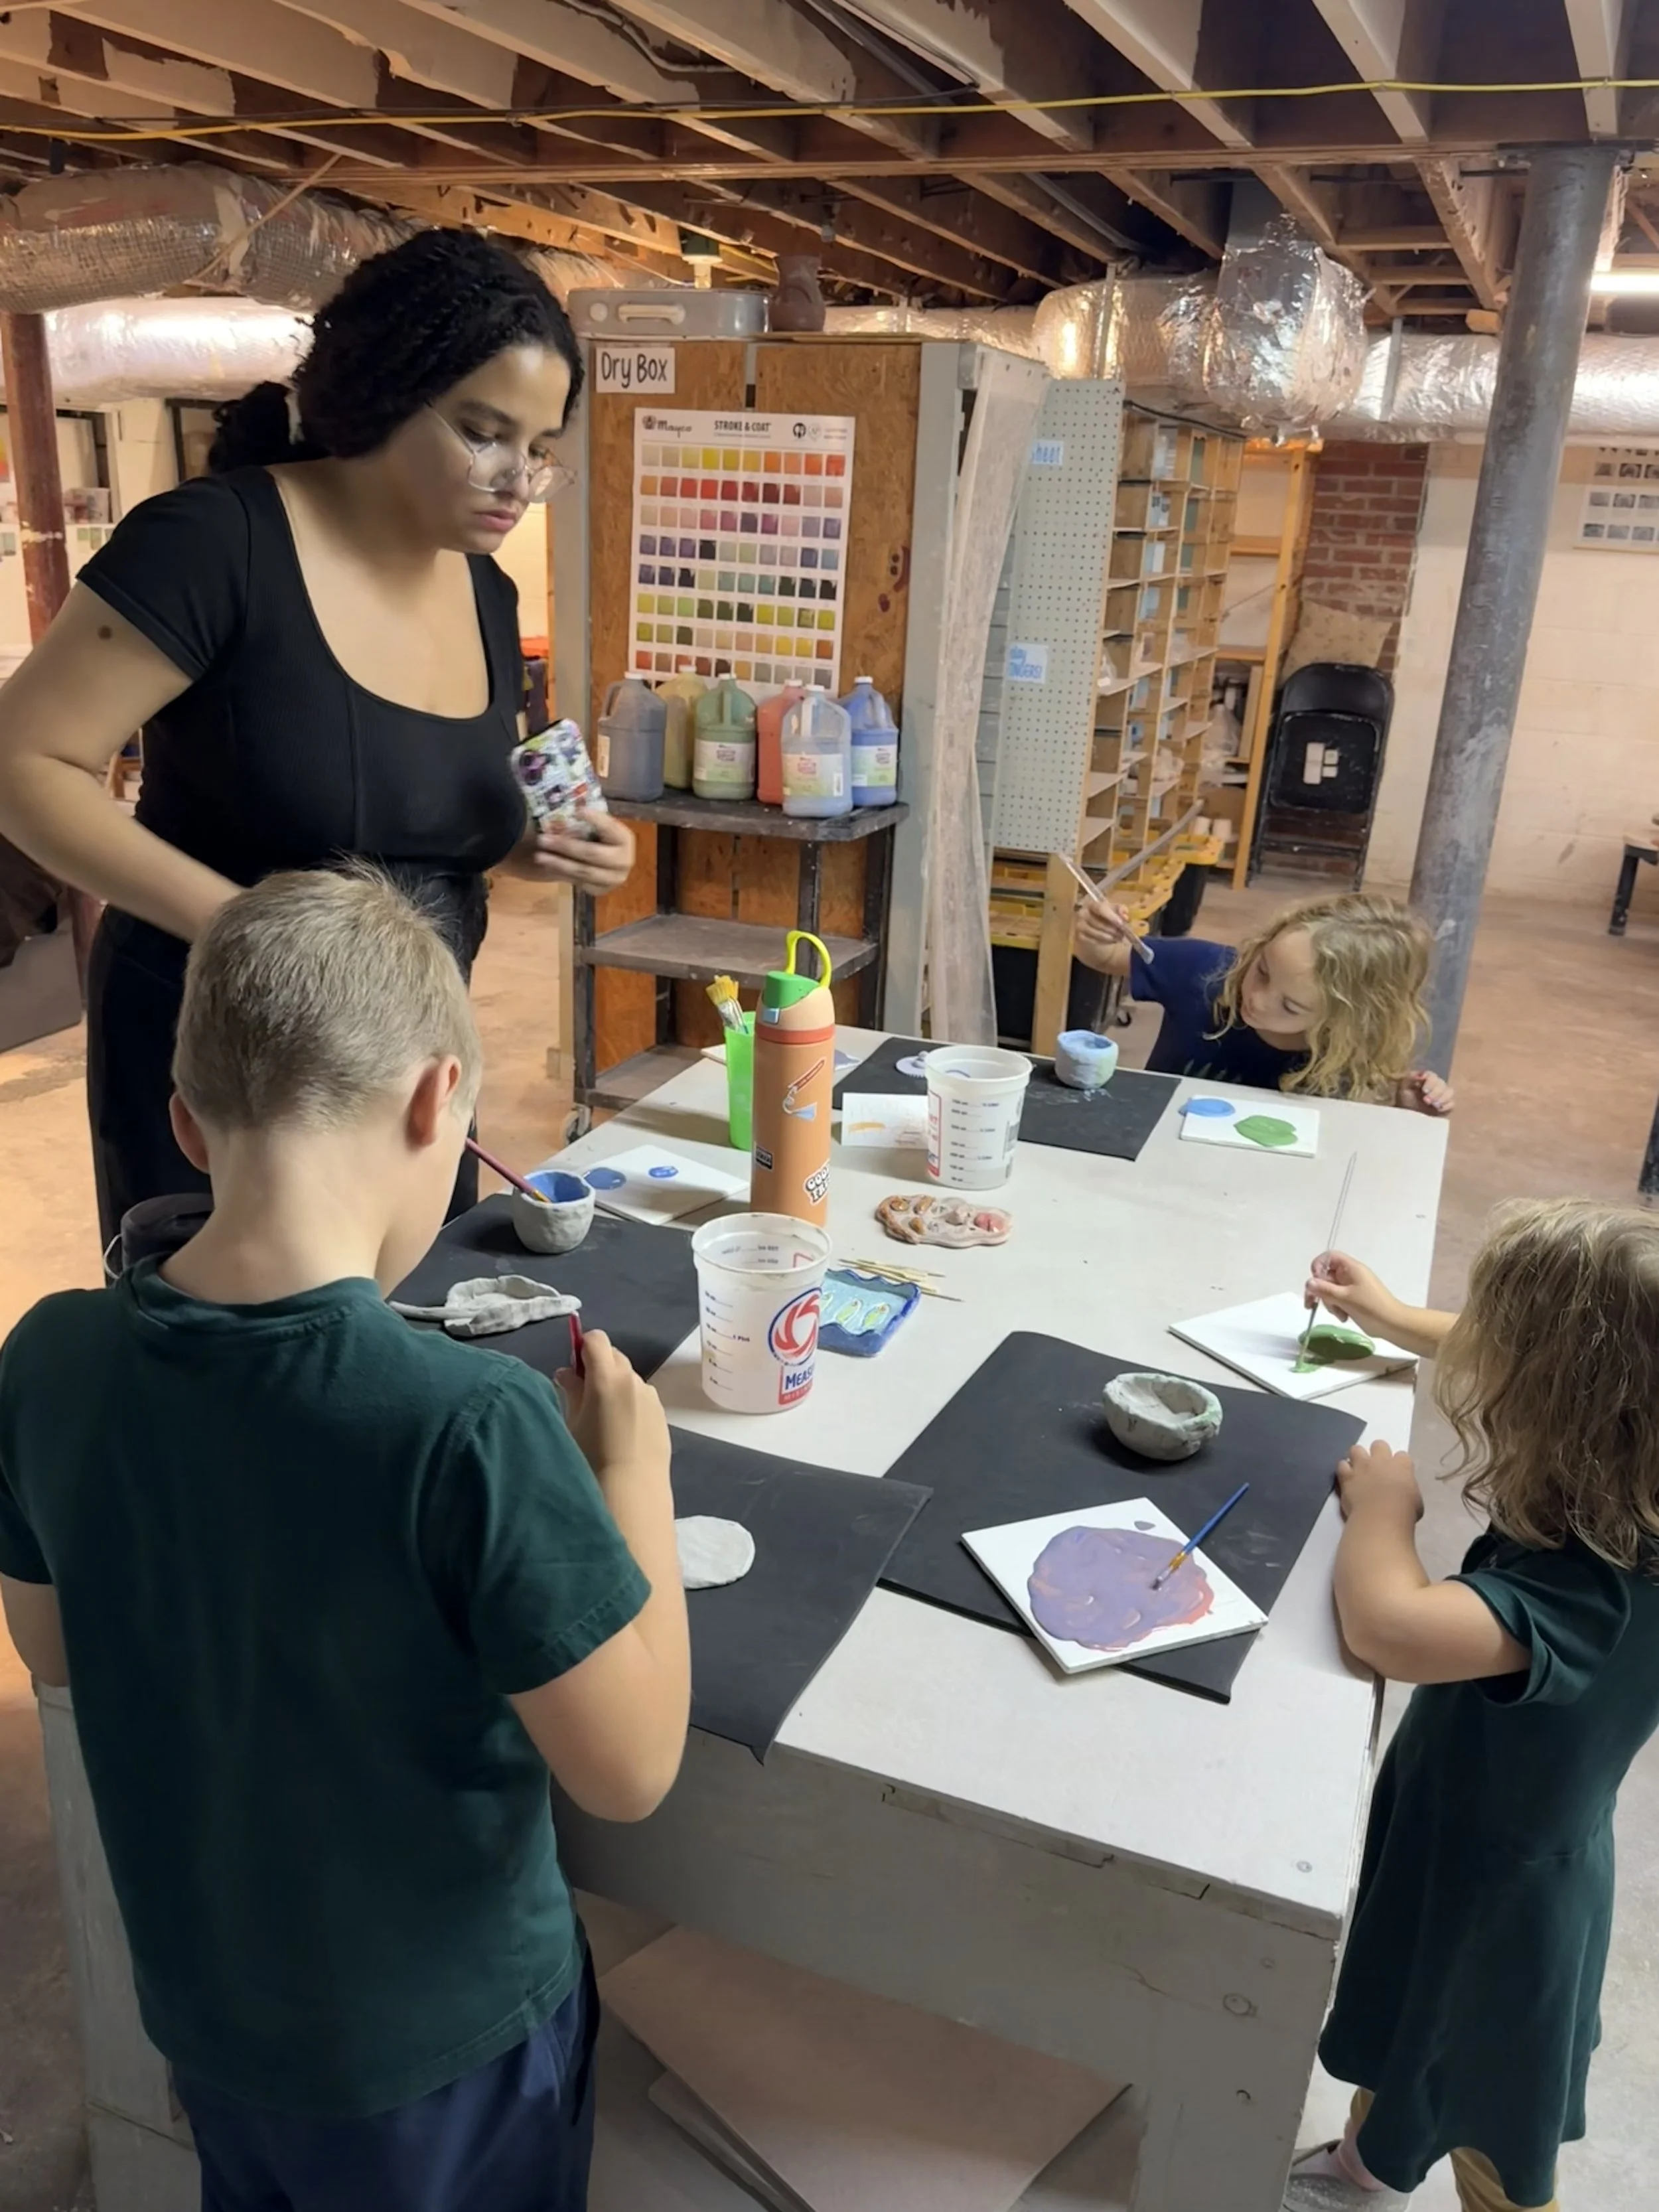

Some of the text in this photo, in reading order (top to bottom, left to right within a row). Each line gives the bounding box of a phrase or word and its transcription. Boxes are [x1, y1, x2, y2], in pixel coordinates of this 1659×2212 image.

[601, 351, 668, 389] Dry Box
[714, 420, 770, 432] STROKE & COAT
